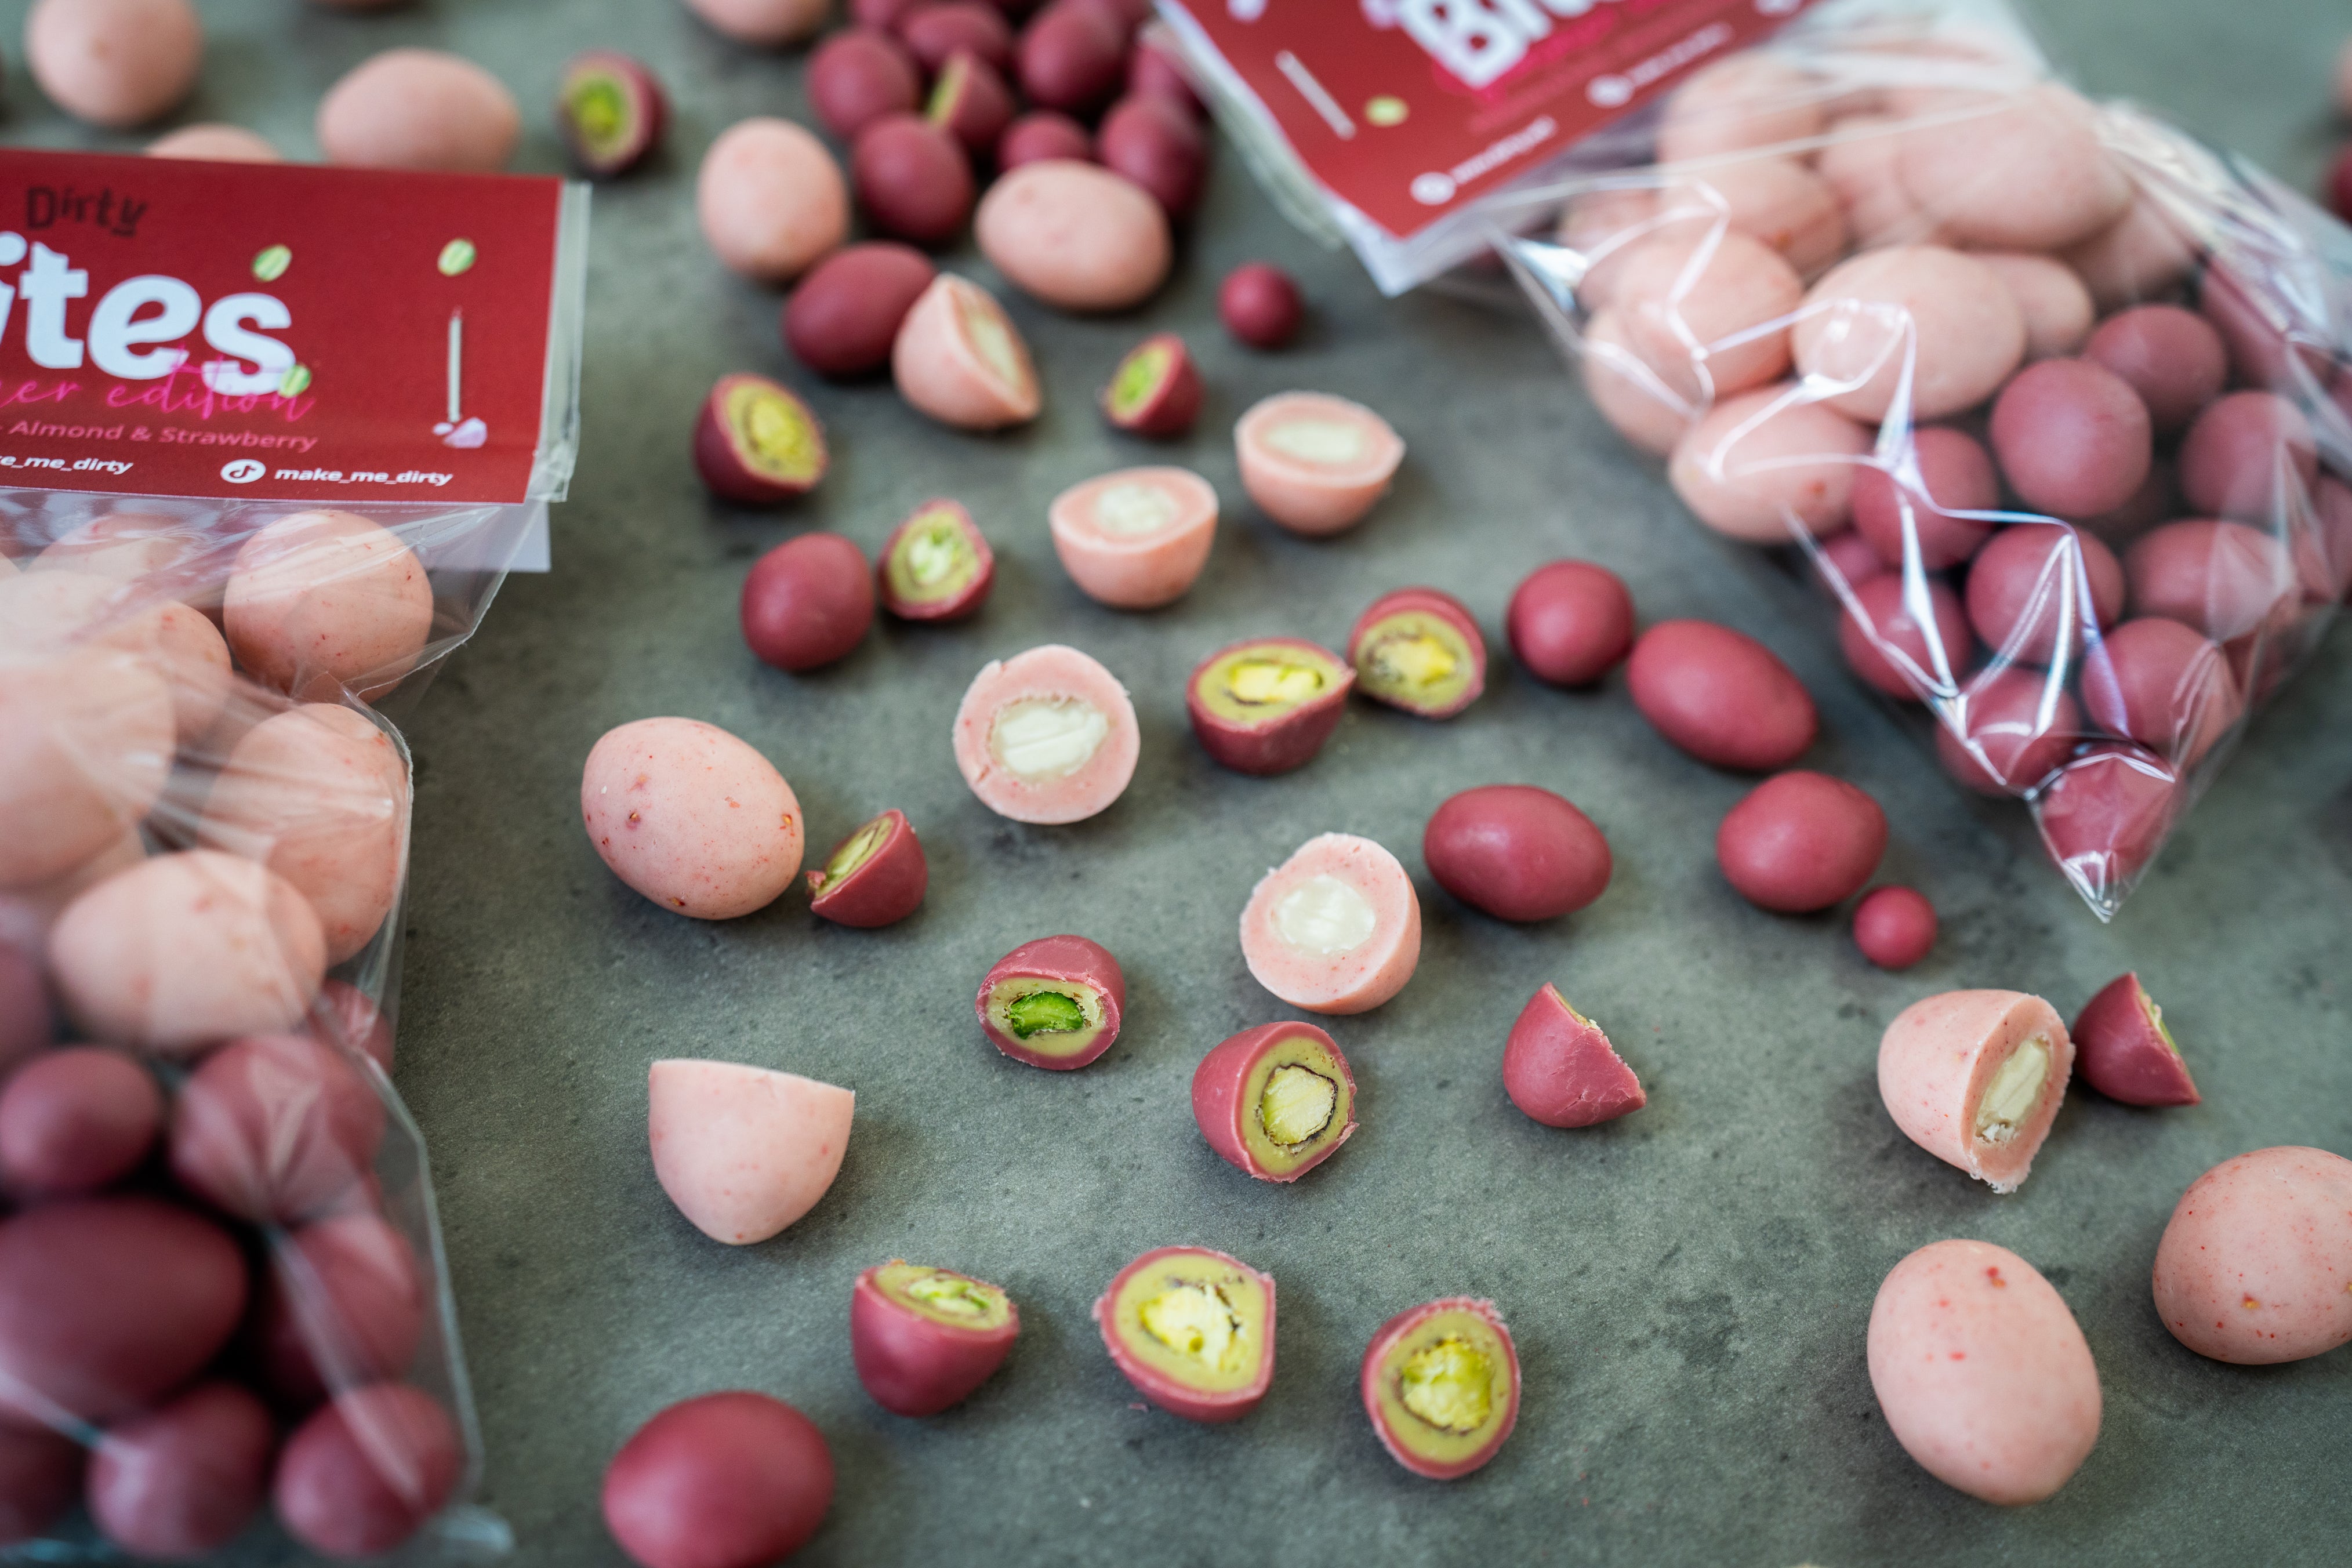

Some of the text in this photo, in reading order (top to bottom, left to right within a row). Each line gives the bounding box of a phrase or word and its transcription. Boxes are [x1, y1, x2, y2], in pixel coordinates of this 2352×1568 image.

[26, 185, 148, 238] Dirty
[0, 341, 315, 422] er edition
[9, 420, 318, 453] Almond & Strawberry
[0, 455, 453, 487] e_me_dirty make_me_dirty
